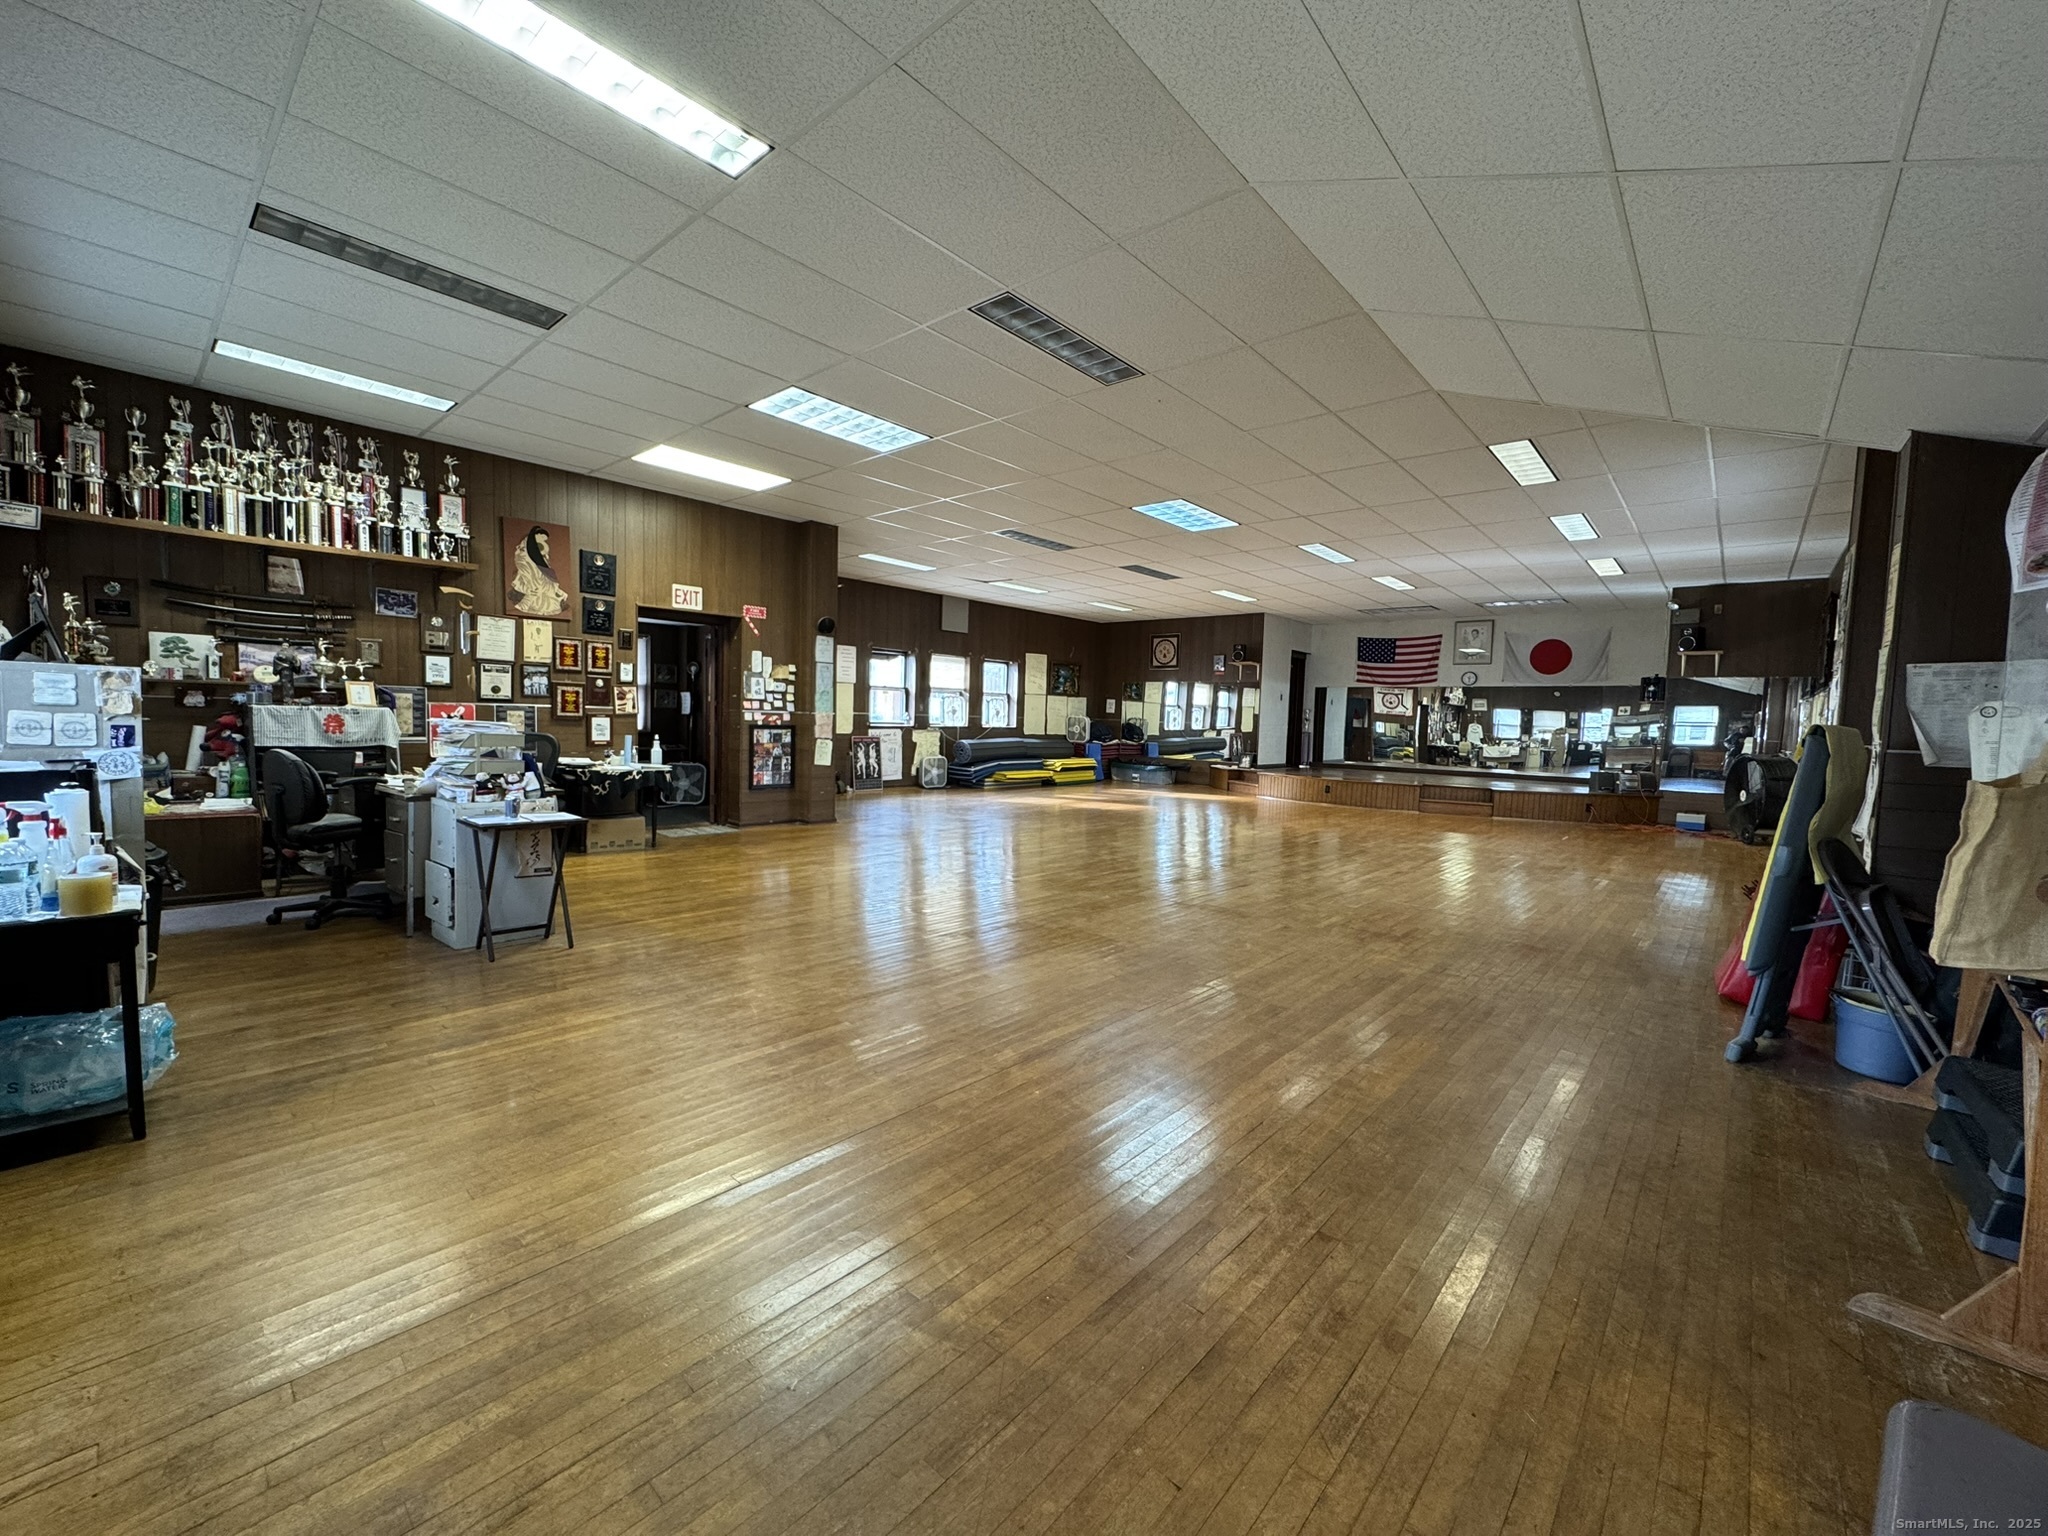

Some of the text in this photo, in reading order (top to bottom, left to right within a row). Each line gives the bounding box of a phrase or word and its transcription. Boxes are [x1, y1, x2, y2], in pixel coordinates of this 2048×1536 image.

[675, 588, 700, 607] EXIT
[30, 1077, 69, 1088] SPRING
[31, 1084, 66, 1094] WATER
